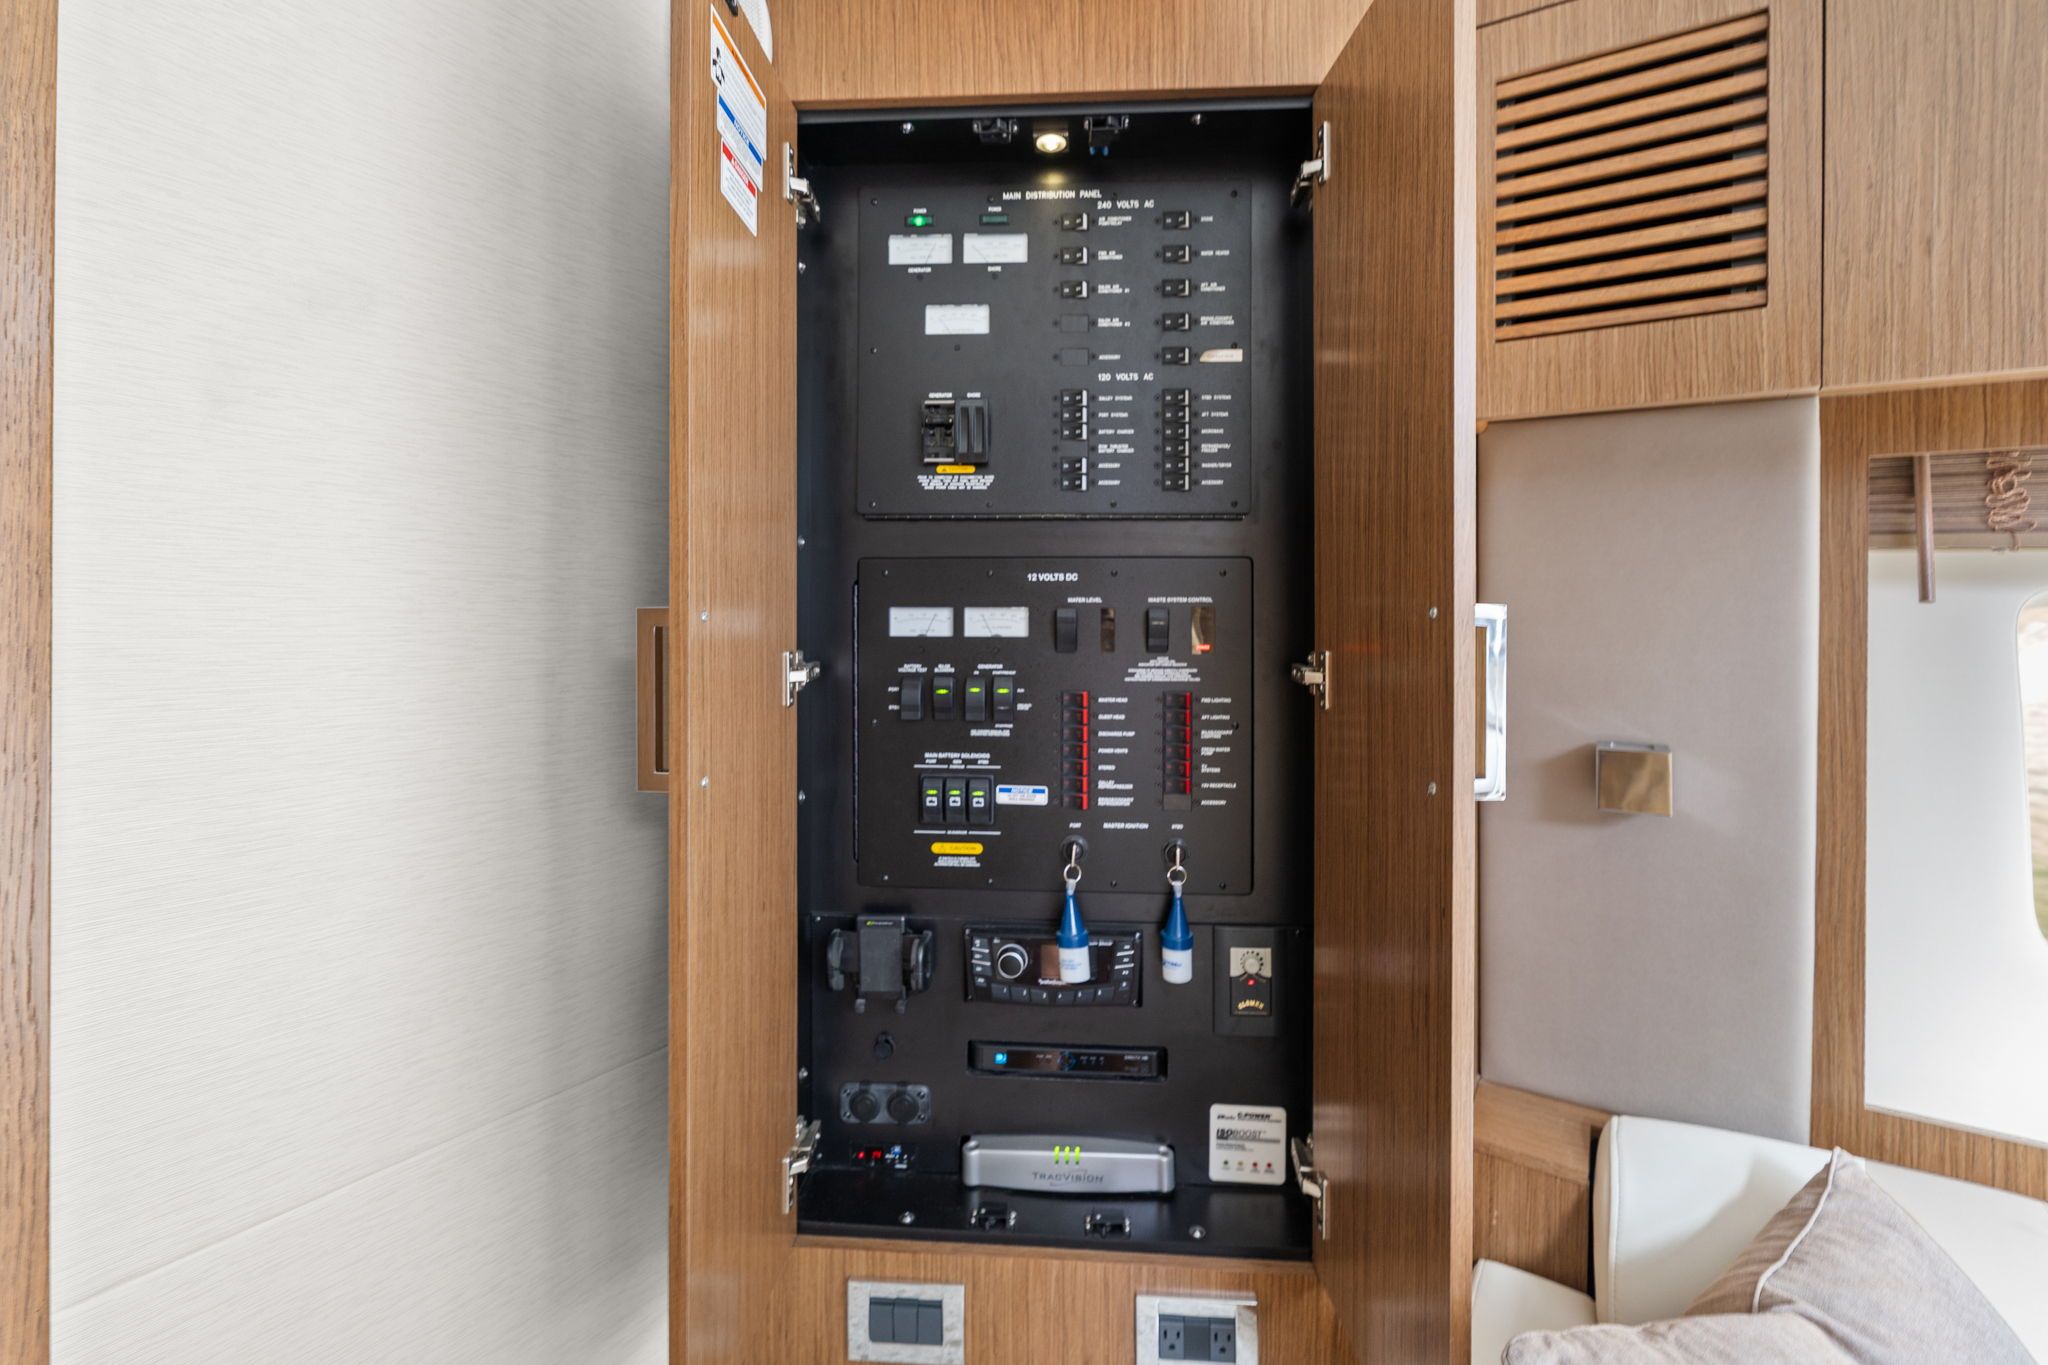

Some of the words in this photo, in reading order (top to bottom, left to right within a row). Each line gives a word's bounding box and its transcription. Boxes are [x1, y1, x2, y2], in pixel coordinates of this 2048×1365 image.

[1003, 192, 1021, 200] MAIN
[1026, 190, 1075, 199] DISTRIBUTION
[1080, 190, 1102, 198] PANEL
[1097, 201, 1112, 209] 240
[1117, 200, 1139, 209] VOLTS
[1144, 200, 1154, 208] AC
[1098, 373, 1111, 381] 120
[1116, 373, 1138, 381] VOLTS
[1028, 573, 1037, 581] 12
[1038, 573, 1063, 582] VOLTS
[1066, 573, 1078, 581] DC
[1032, 1172, 1104, 1184] TRACVISION
